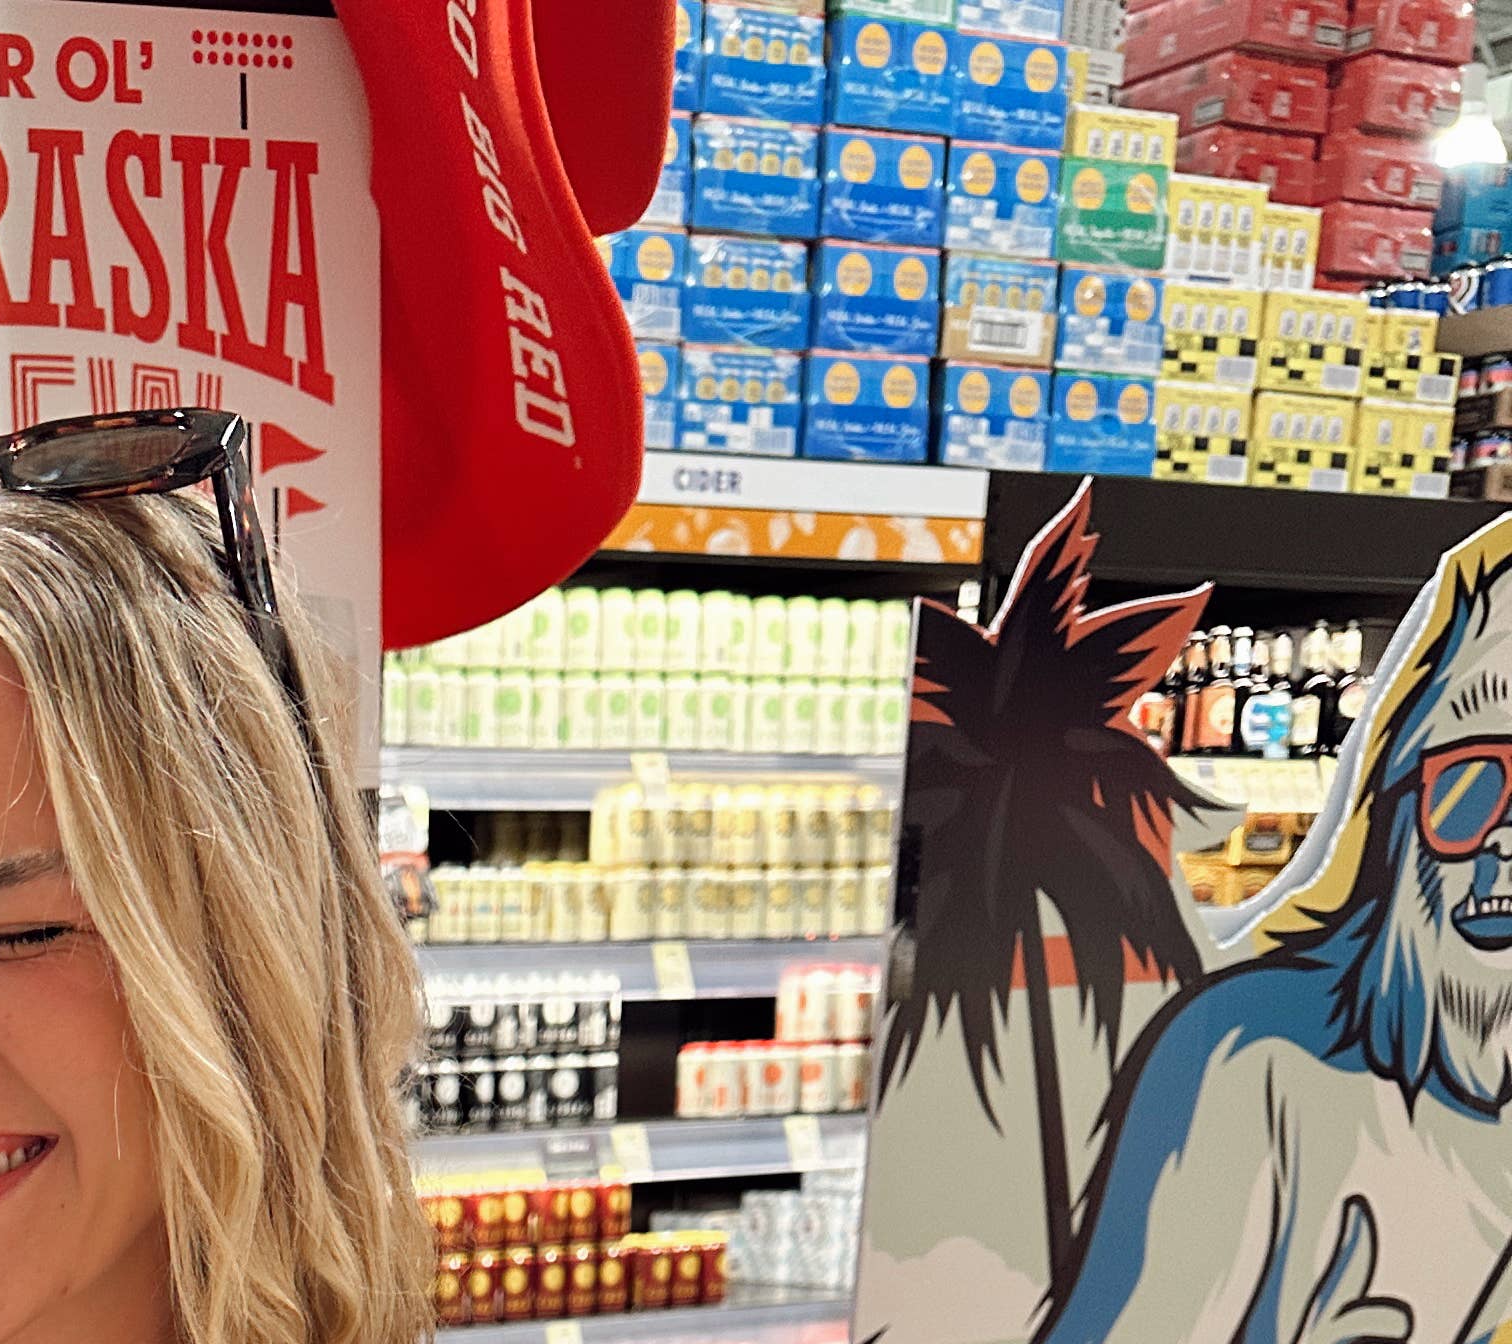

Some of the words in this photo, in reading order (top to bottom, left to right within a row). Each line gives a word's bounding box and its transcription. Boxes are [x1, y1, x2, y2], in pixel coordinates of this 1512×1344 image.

[55, 39, 153, 104] OL'
[460, 92, 527, 255] BIG
[499, 265, 575, 448] RED
[673, 468, 743, 495] CIDER
